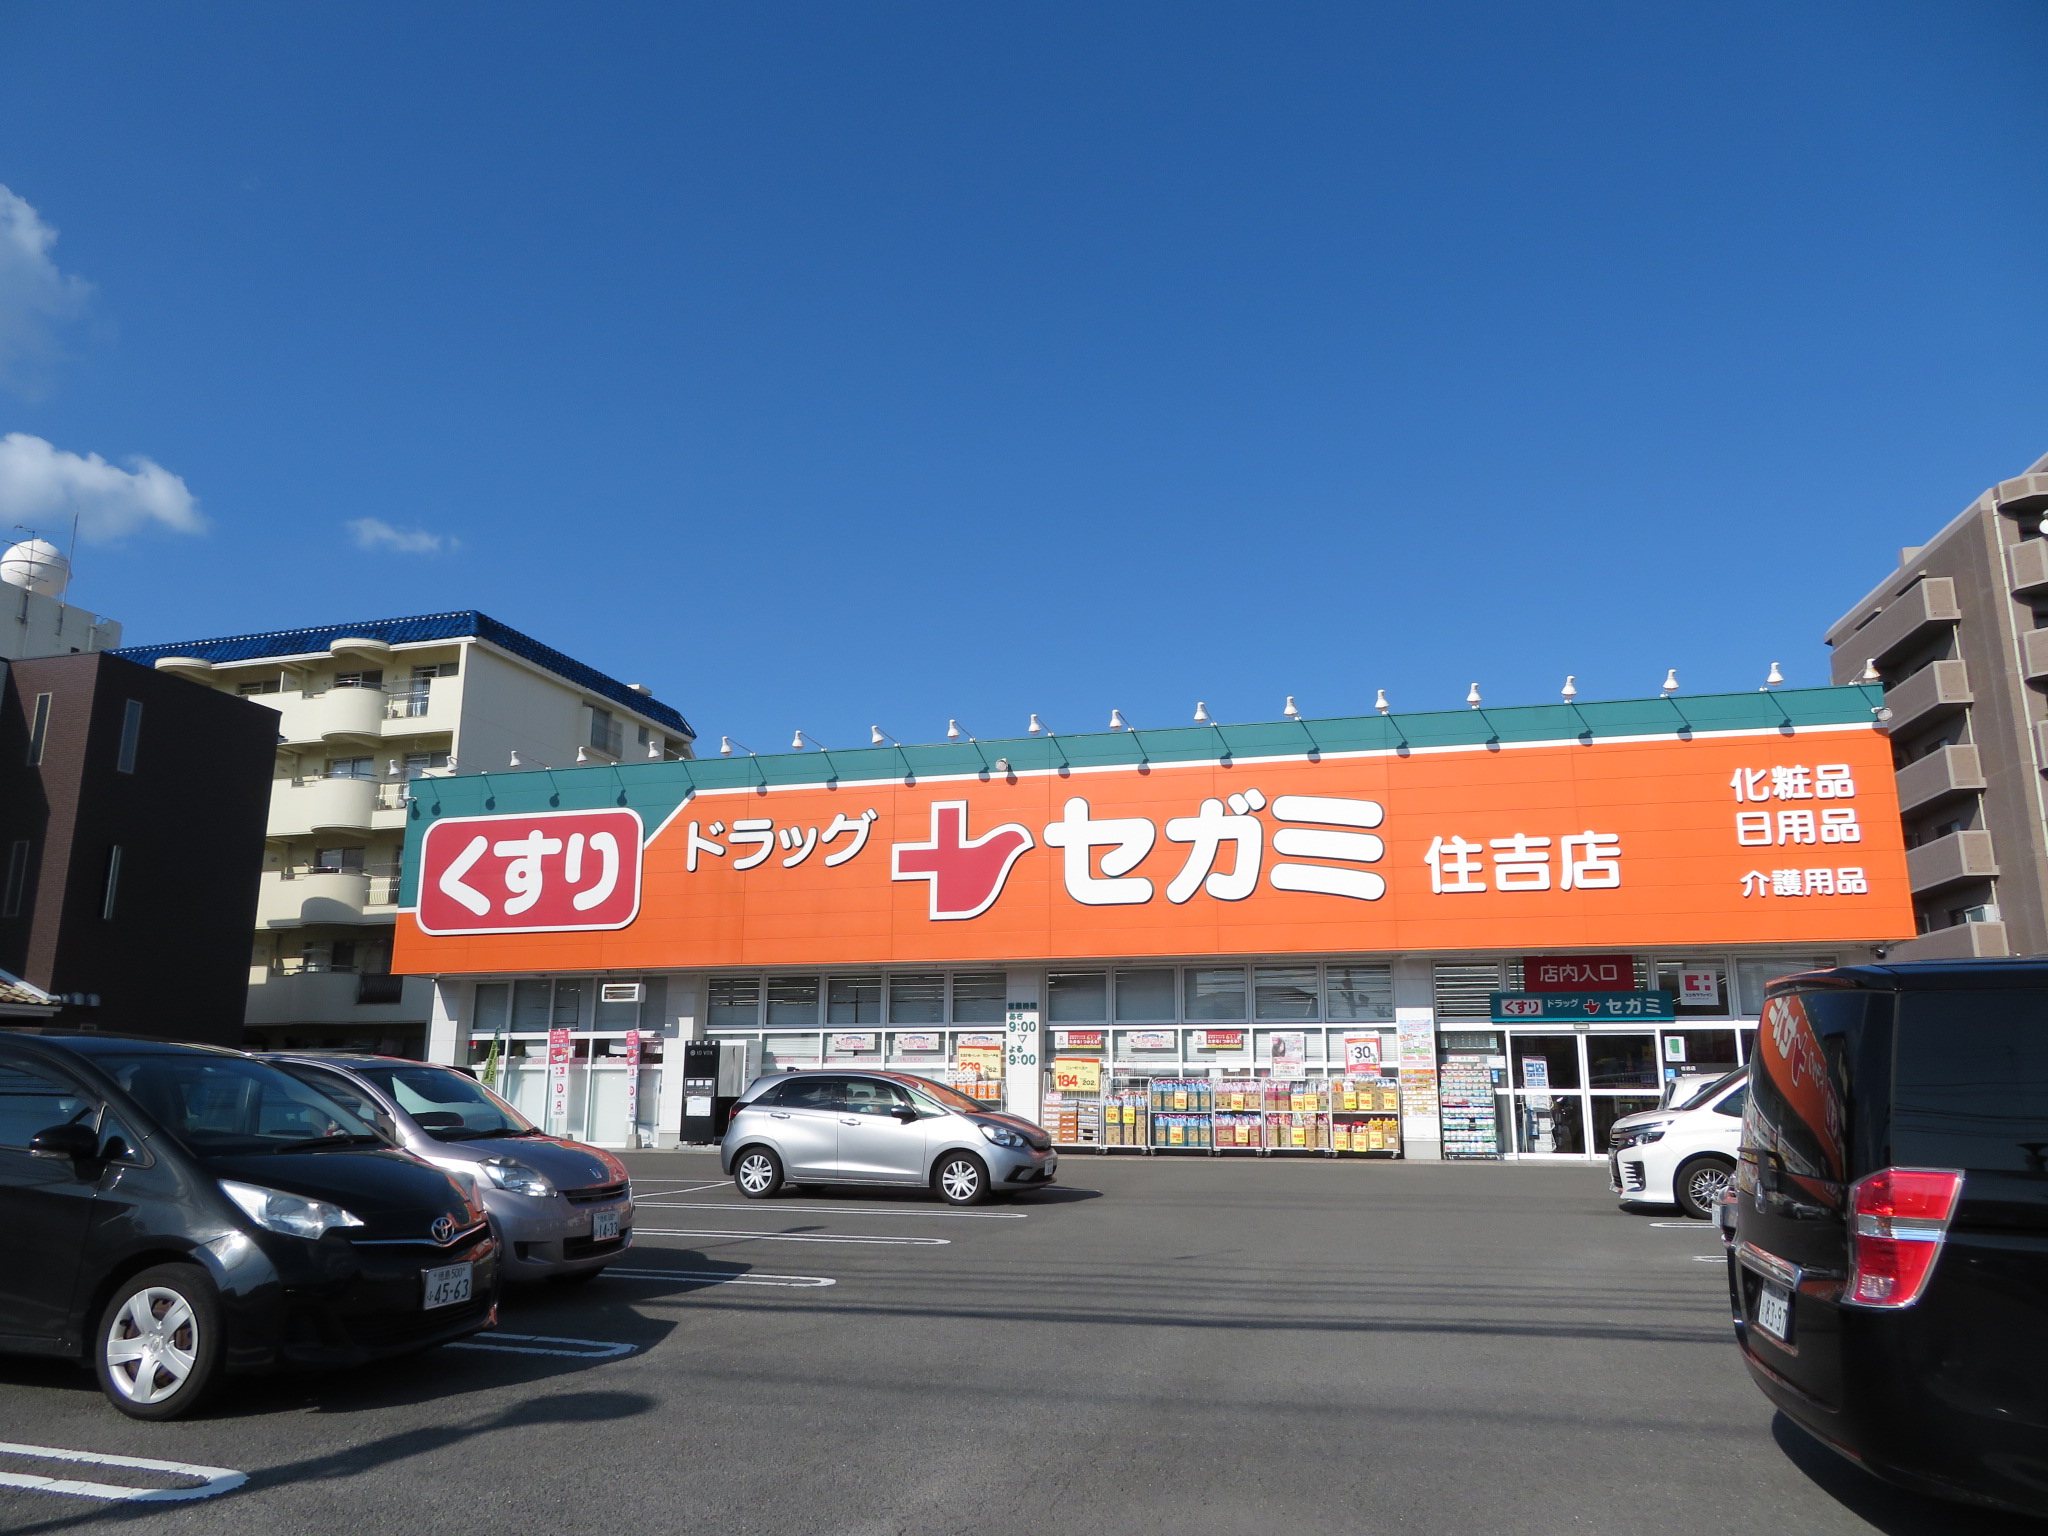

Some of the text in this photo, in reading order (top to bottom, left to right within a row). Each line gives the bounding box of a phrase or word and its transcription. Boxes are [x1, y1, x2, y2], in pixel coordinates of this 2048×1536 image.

[1730, 764, 1855, 803] 化粧品
[1735, 807, 1861, 846] 日用品
[686, 788, 1622, 905] ドラッグ セガミ 住吉店
[439, 829, 620, 917] くすり
[1740, 867, 1868, 898] 介護用品
[1540, 964, 1618, 983] 店内入口
[1503, 999, 1539, 1015] くすり
[1547, 998, 1661, 1015] ドラッグ セガミ
[1009, 1012, 1023, 1020] あさ
[1009, 1021, 1036, 1032] 9:00
[1009, 1045, 1023, 1053] よる
[1354, 1046, 1371, 1059] 30
[1009, 1054, 1036, 1065] 9:00
[1057, 1074, 1078, 1087] 184
[434, 1279, 469, 1303] 45-63
